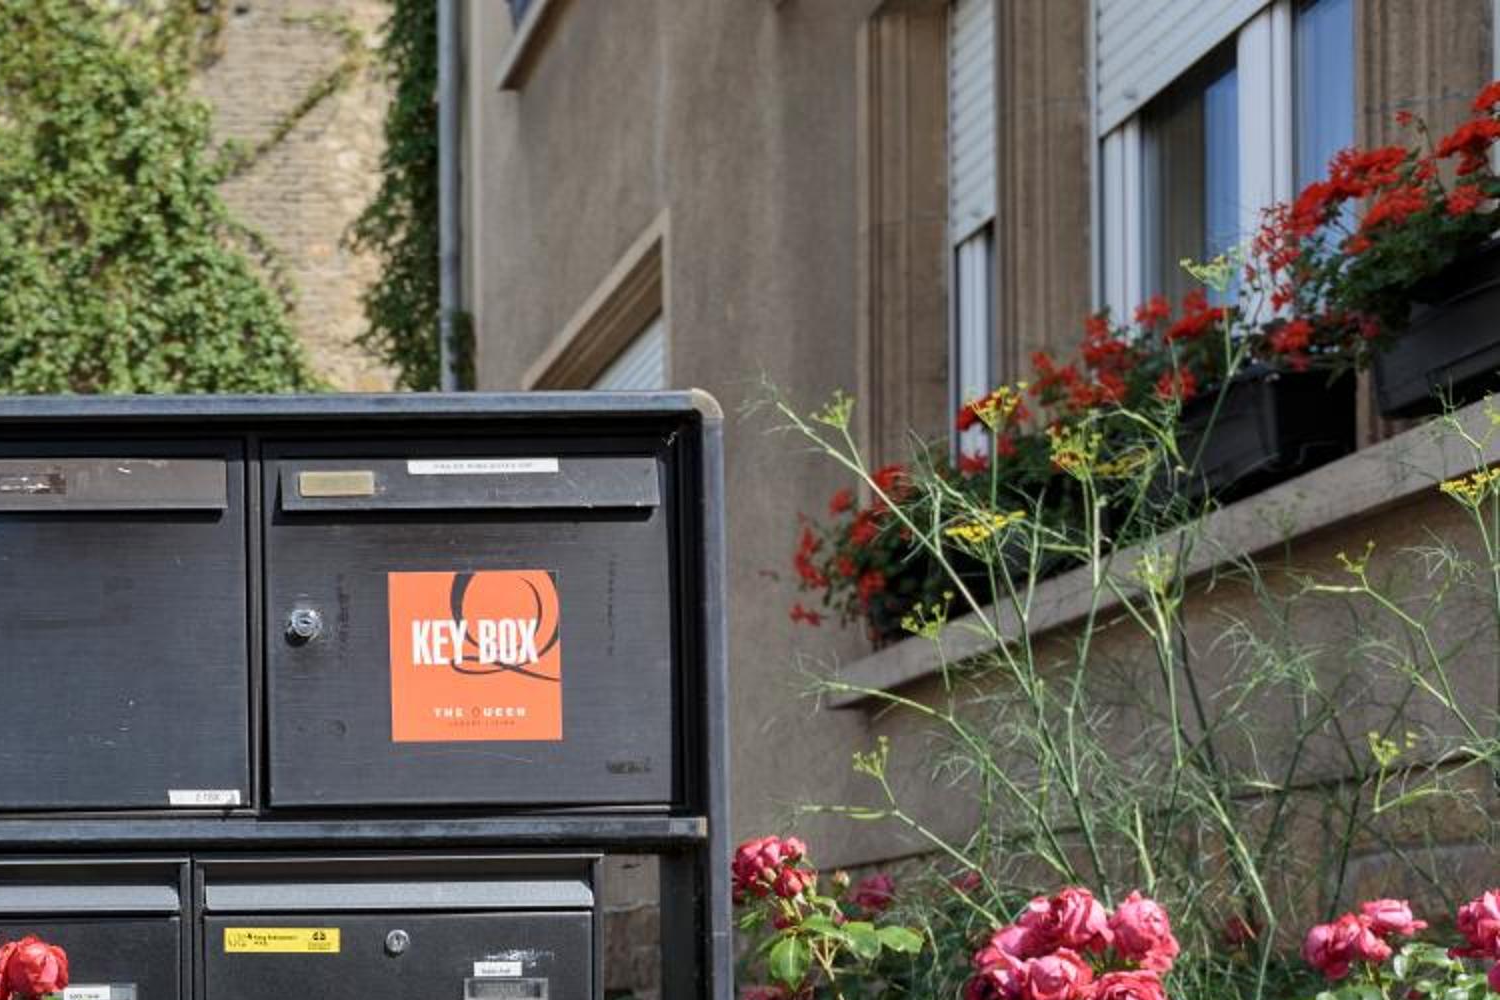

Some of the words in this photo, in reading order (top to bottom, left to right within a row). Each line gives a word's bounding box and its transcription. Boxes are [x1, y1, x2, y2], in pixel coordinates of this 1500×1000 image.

[411, 618, 468, 666] KEY
[478, 617, 540, 665] BOX
[433, 706, 465, 718] THE
